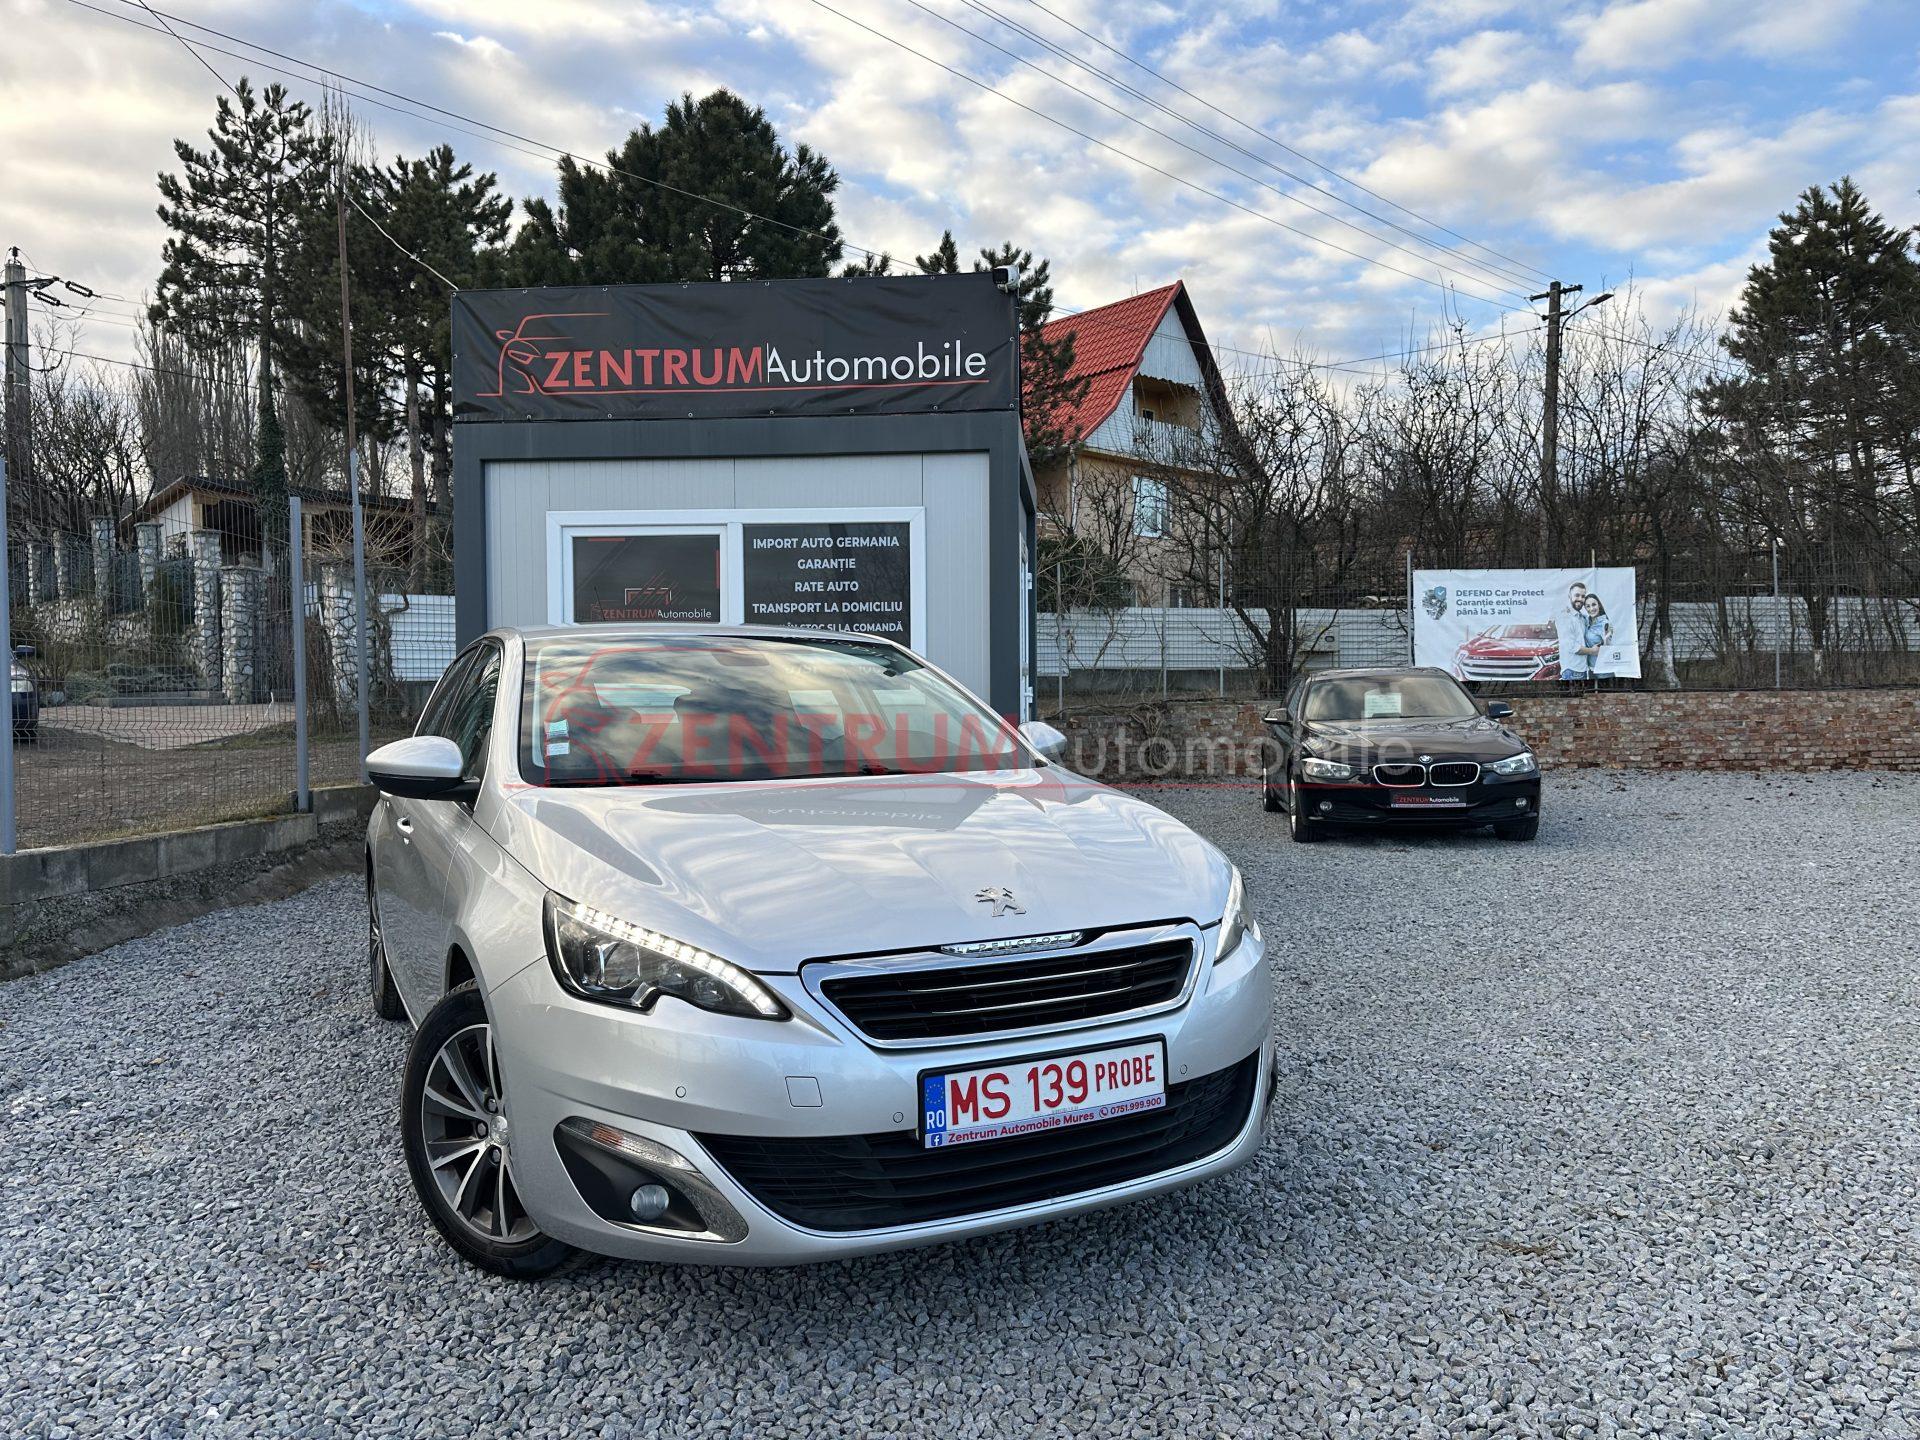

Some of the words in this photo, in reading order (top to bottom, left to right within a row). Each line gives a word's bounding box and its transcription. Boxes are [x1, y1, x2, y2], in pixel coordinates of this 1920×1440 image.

[543, 346, 762, 388] ZENTRUM
[767, 339, 987, 383] Automobile
[753, 538, 798, 549] IMPORT
[801, 537, 834, 548] AUTO
[836, 536, 900, 548] GERMANIA
[797, 558, 856, 572] GARANȚIE
[795, 581, 823, 592] RATE
[827, 580, 859, 591] AUTO
[603, 608, 657, 619] ZENTRUM
[657, 608, 712, 619] Automobile
[752, 602, 821, 614] TRANSPORT
[824, 601, 839, 613] LA
[841, 601, 902, 612] DOMICILIU
[1480, 607, 1488, 615] la
[1497, 607, 1511, 615] ani
[838, 623, 850, 633] LA
[853, 620, 904, 632] COMANDĂ
[978, 935, 1063, 953] PEUGEOT
[926, 1109, 945, 1130] RO
[950, 1072, 1011, 1126] MS
[1027, 1060, 1089, 1112] 139
[1095, 1054, 1155, 1092] PROBE
[948, 1128, 998, 1144] Zentrum
[1000, 1117, 1061, 1135] Automobile
[1063, 1111, 1095, 1124] Mures
[1110, 1096, 1162, 1115] 0751.999.900
